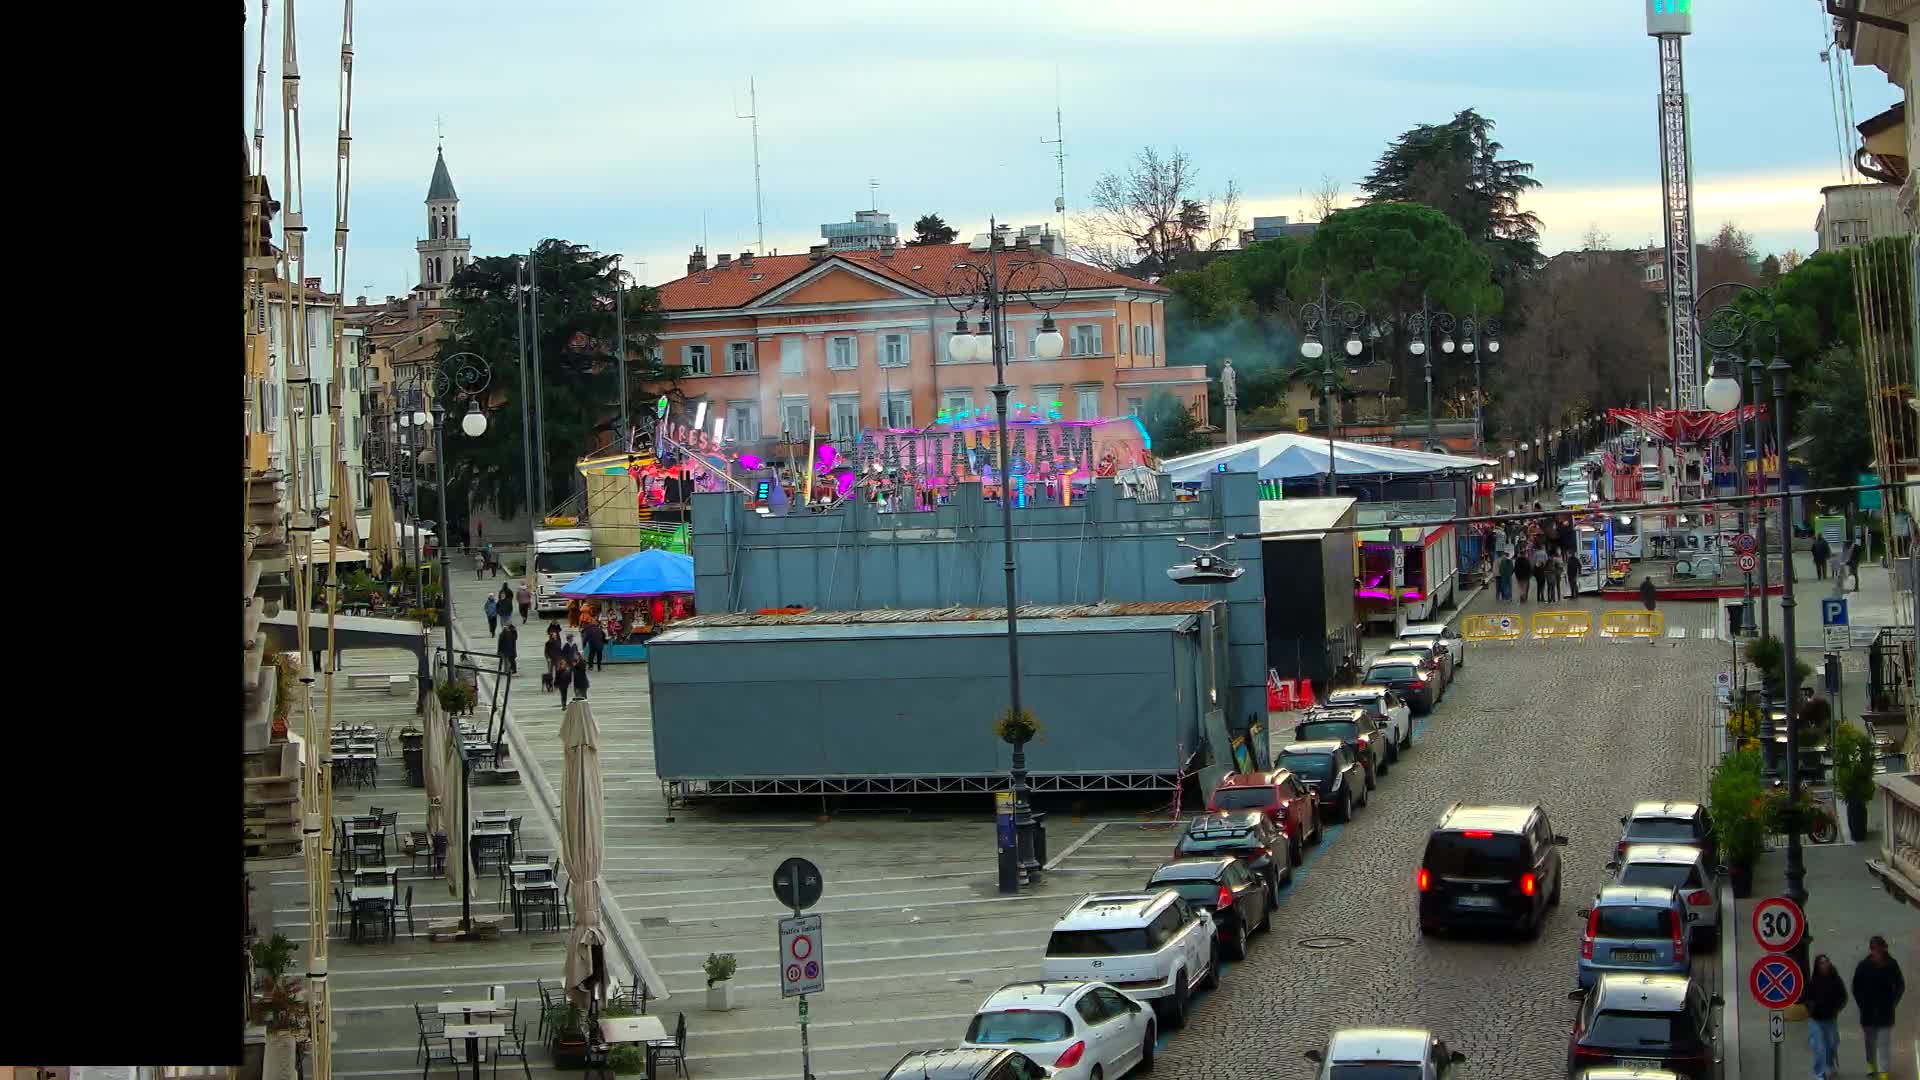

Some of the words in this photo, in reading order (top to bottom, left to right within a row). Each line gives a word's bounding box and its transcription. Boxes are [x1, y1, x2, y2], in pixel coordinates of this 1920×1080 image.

[1742, 558, 1753, 567] 20
[1826, 602, 1842, 622] P
[1762, 911, 1792, 938] 30
